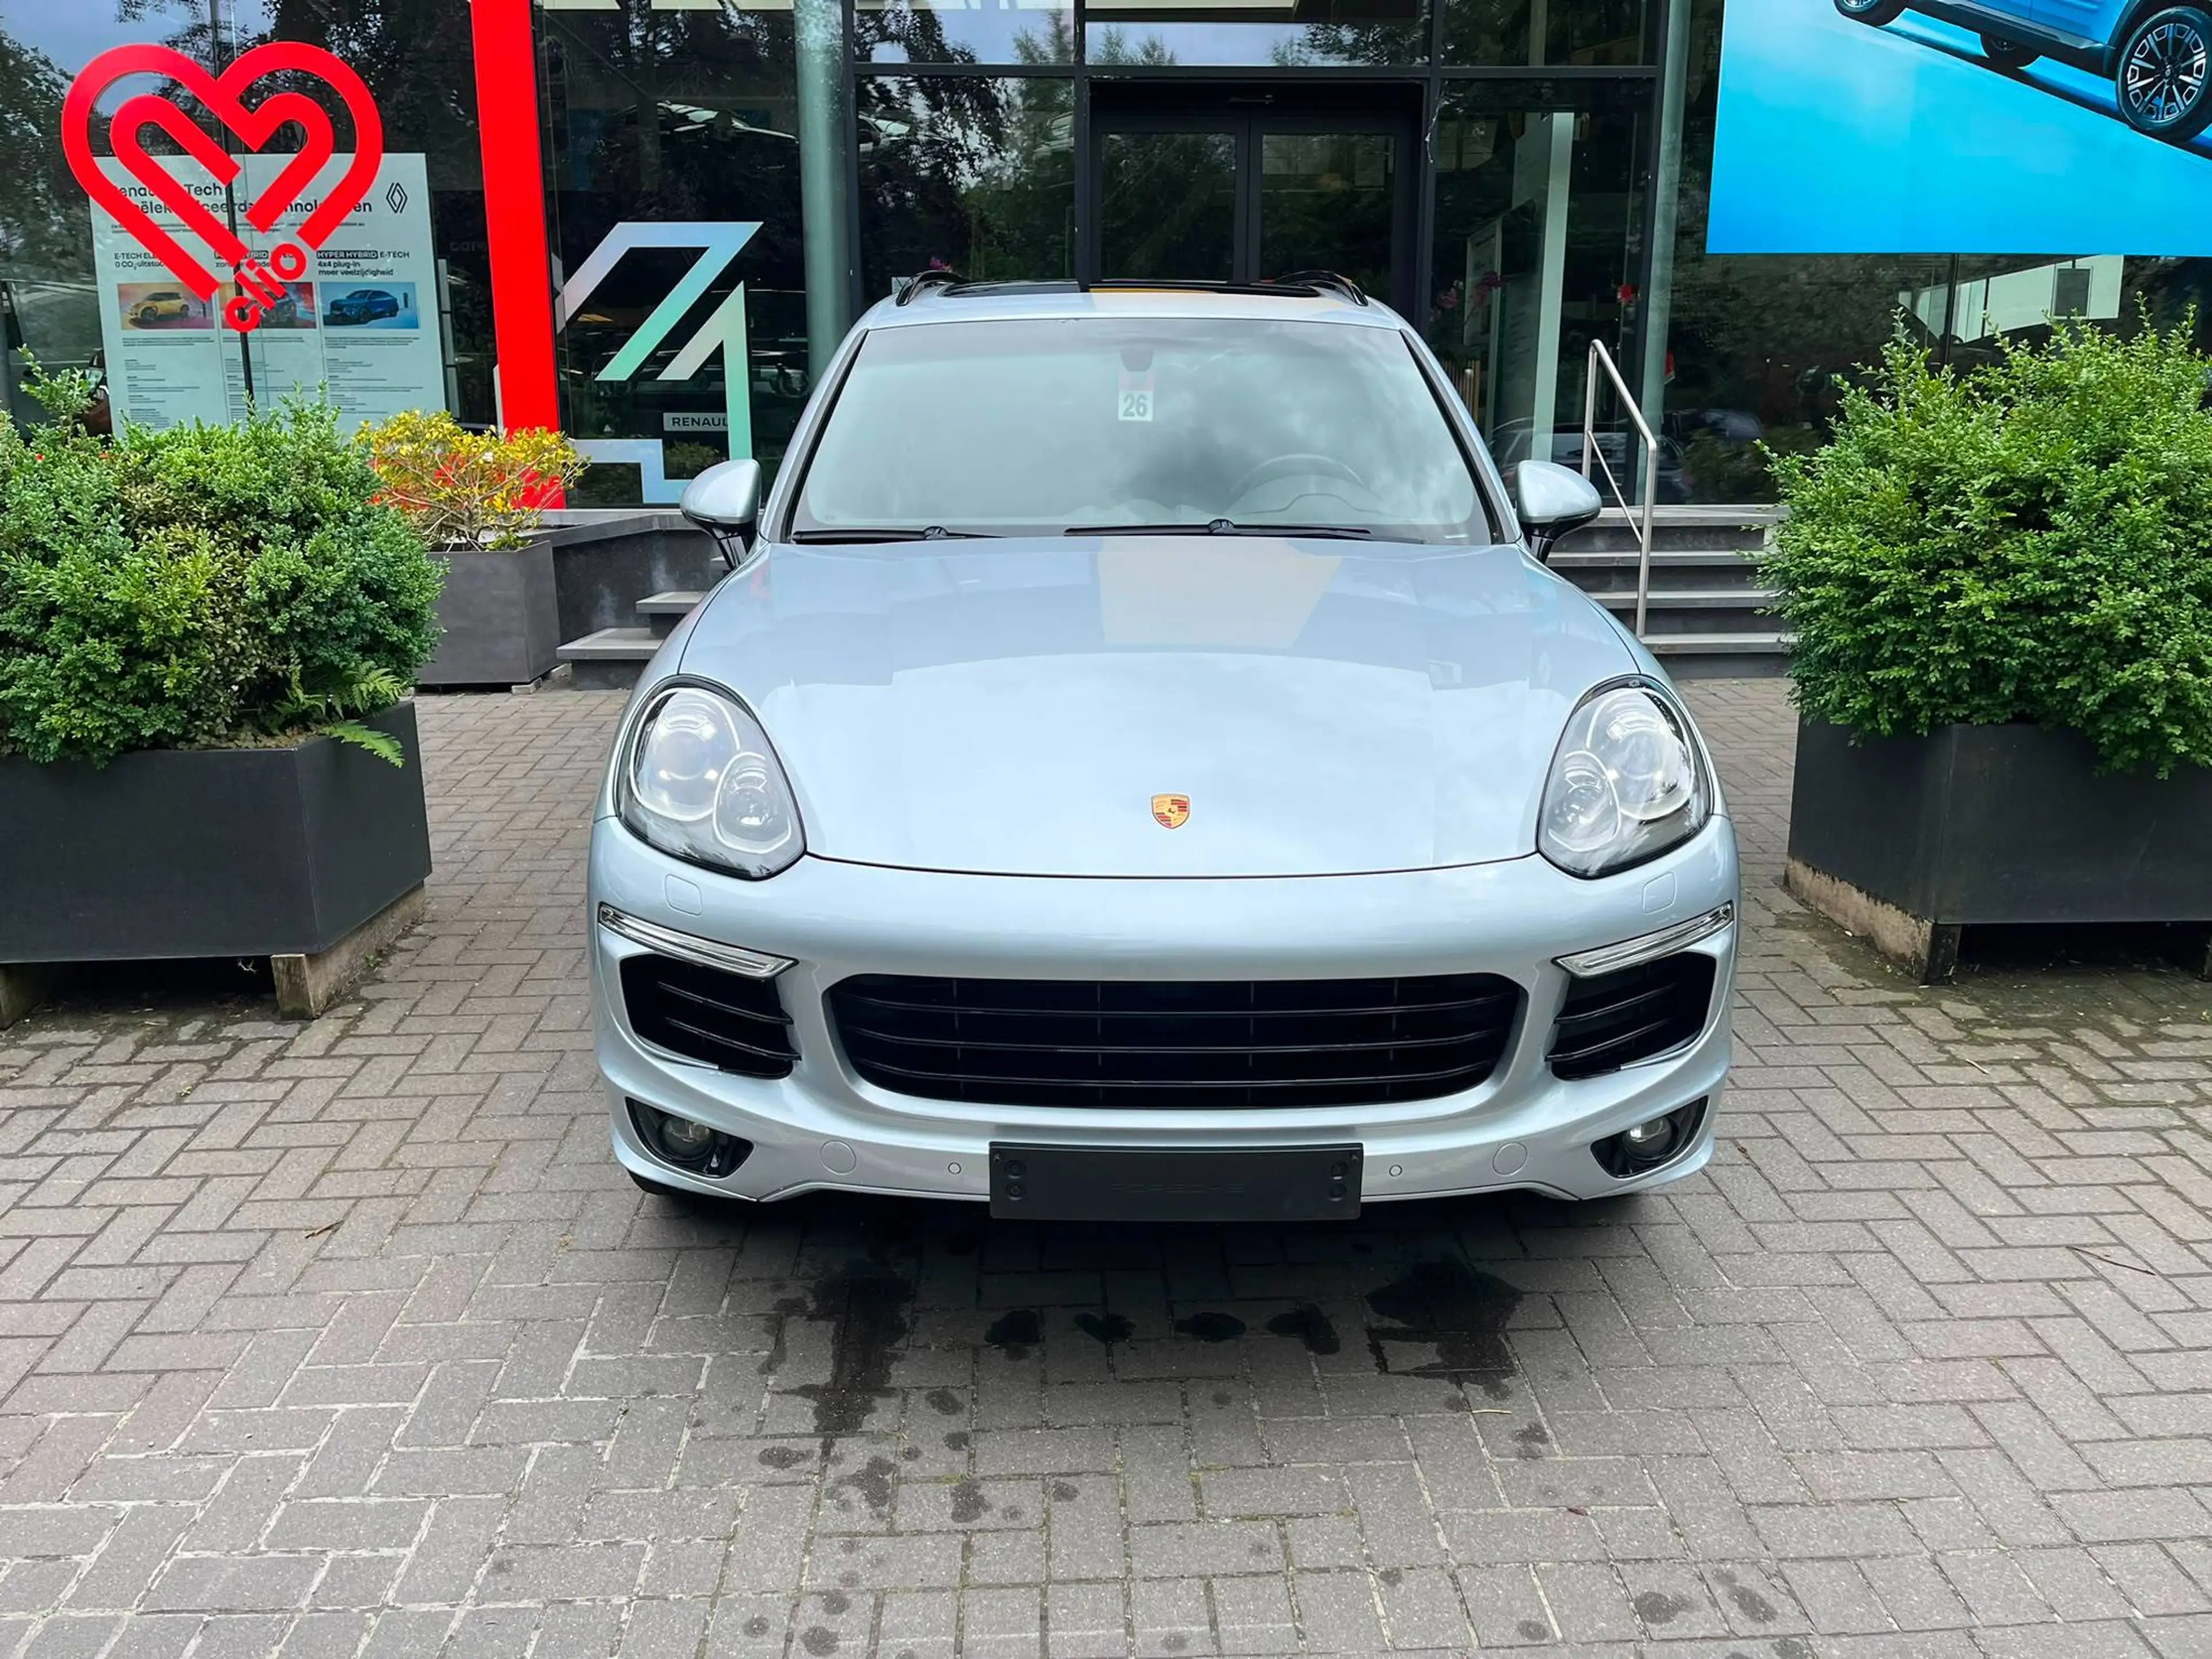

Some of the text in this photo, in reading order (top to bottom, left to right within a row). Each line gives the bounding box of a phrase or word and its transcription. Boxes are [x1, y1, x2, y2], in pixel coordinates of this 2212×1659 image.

[333, 260, 361, 269] plug-in
[225, 242, 306, 333] clio
[1123, 393, 1147, 417] 26
[672, 417, 728, 427] RENAUL
